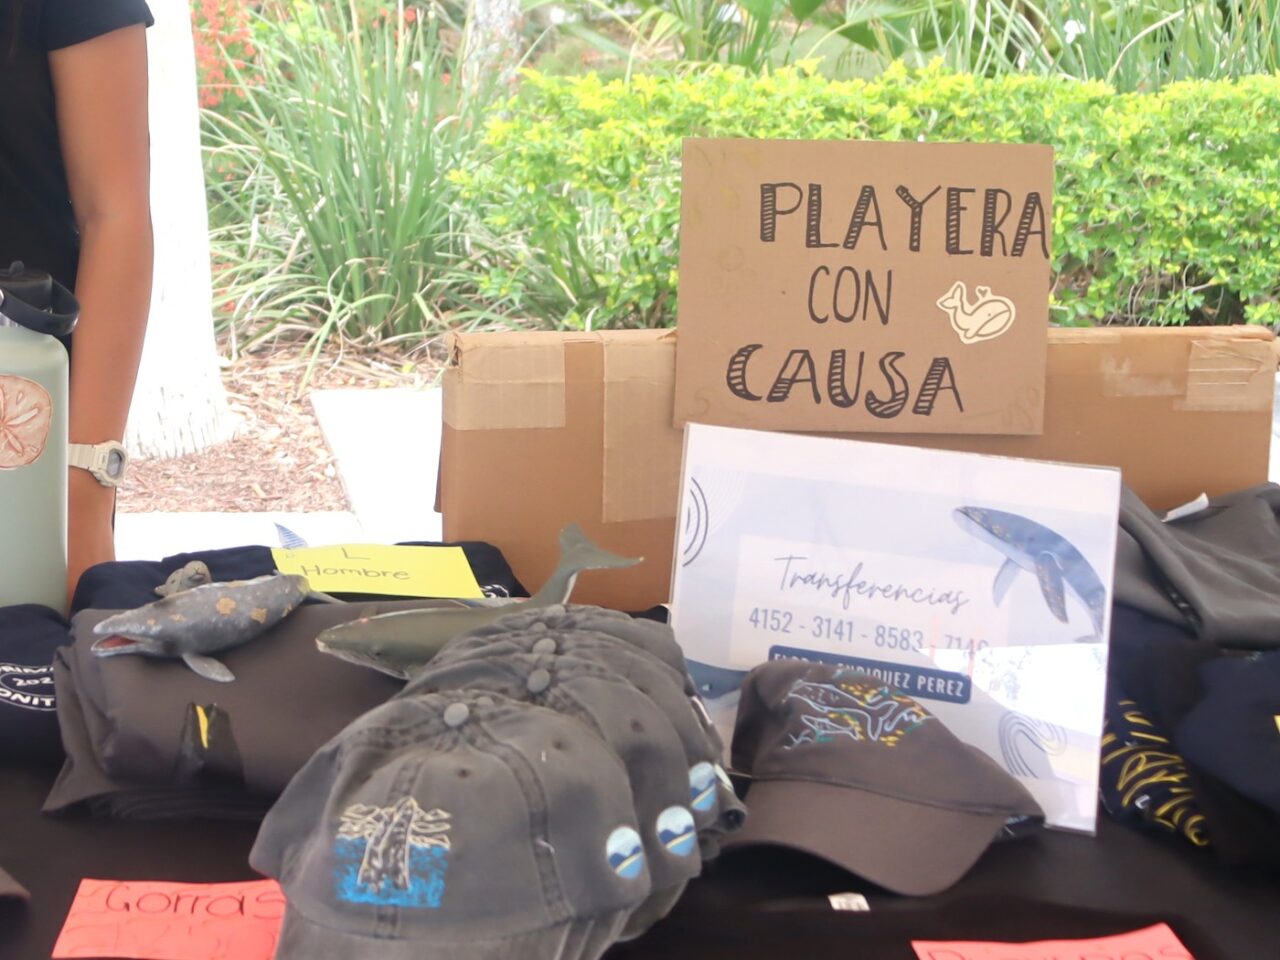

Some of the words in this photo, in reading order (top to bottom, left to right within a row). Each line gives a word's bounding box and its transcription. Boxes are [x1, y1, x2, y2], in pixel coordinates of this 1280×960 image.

[760, 182, 1050, 259] PLAYERA
[808, 265, 893, 325] CON
[726, 344, 964, 419] CAUSA
[301, 564, 411, 580] Hombre
[774, 554, 971, 615] Transferencias
[749, 607, 793, 634] 4152
[811, 616, 854, 642] 3141
[874, 625, 924, 652] 8583
[917, 674, 965, 698] PEREZ
[106, 884, 286, 920] Gorras
